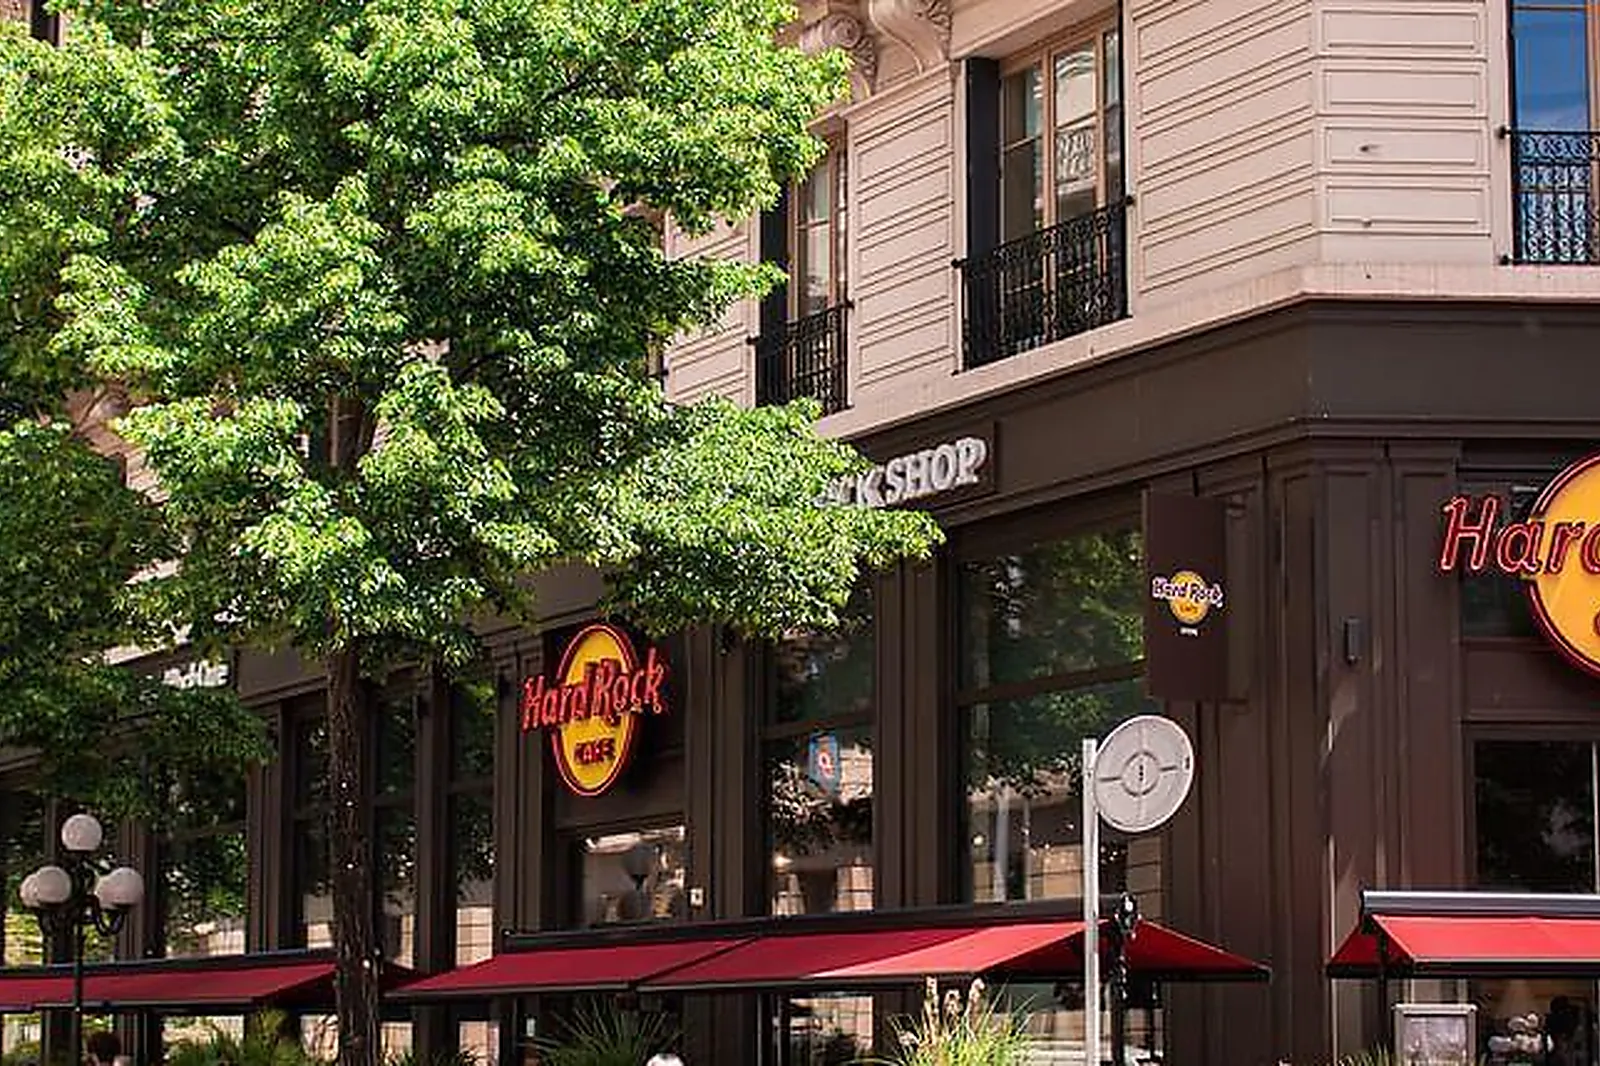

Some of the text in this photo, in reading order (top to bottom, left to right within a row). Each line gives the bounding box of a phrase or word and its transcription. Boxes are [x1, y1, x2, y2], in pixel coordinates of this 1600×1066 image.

[886, 437, 987, 503] SHOP
[521, 648, 666, 732] Hard Rock
